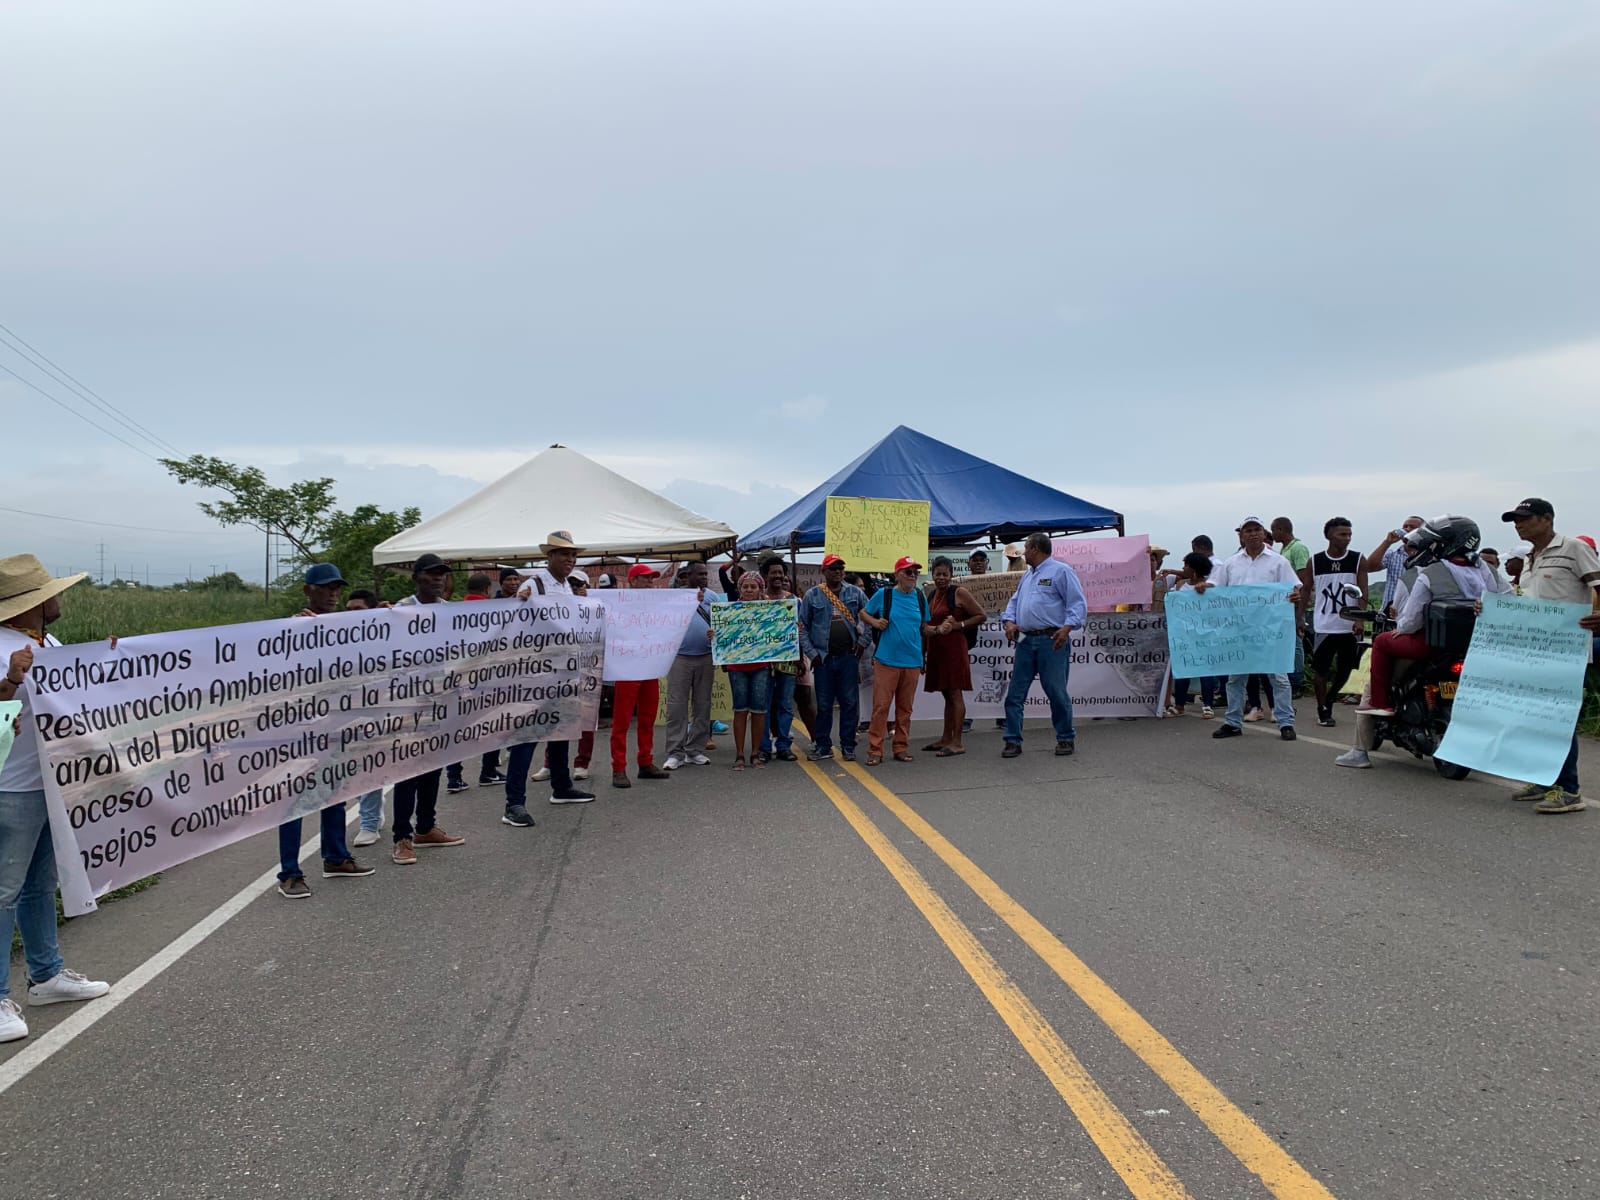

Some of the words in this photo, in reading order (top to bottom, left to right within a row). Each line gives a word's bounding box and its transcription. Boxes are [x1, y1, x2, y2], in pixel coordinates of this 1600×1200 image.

[33, 649, 192, 695] Rechazamos
[215, 636, 236, 664] la
[257, 618, 391, 660] adjudicación
[408, 612, 436, 636] del
[453, 602, 571, 632] magaproyecto
[1090, 635, 1110, 648] de
[1113, 635, 1135, 647] los
[1094, 652, 1139, 665] Canal
[1143, 650, 1165, 663] del
[1127, 618, 1149, 631] 5G
[36, 683, 202, 742] Restauración
[210, 658, 323, 707] Ambiental
[329, 656, 353, 681] de
[359, 652, 386, 675] los
[392, 635, 508, 669] Escosistemas
[51, 742, 120, 786] anal
[127, 731, 161, 768] del
[172, 719, 246, 754] Dique,
[257, 696, 330, 732] debido
[340, 694, 352, 711] a
[362, 685, 379, 707] la
[389, 675, 434, 703] falta
[443, 671, 462, 691] de
[469, 656, 558, 690] garantías,
[164, 770, 191, 799] de
[203, 758, 225, 786] la
[238, 730, 329, 775] consulta
[341, 712, 404, 753] previa
[413, 709, 424, 732] y
[432, 700, 448, 722] la
[171, 770, 318, 838] comunitarios
[322, 757, 358, 790] que
[363, 749, 386, 773] no
[391, 733, 450, 763] fueron
[454, 709, 561, 744] consultados
